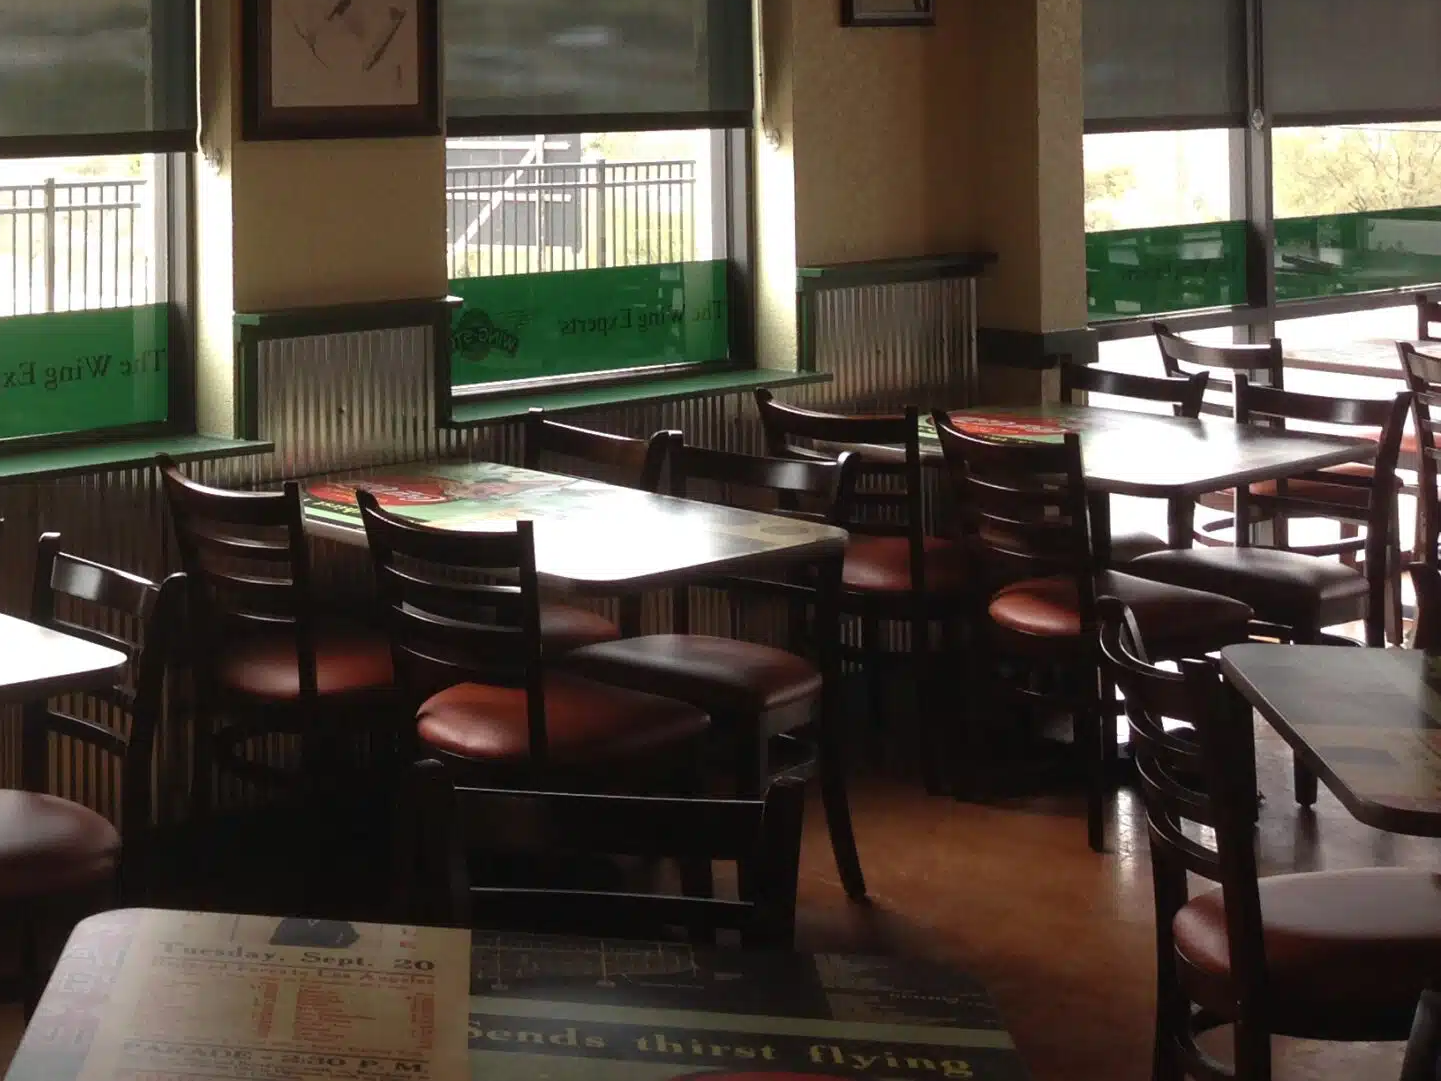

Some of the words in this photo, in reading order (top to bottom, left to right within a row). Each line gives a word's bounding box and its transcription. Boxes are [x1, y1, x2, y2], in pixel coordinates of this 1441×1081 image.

[392, 958, 435, 971] 20
[468, 1019, 608, 1050] Sends
[636, 1032, 777, 1063] thirst
[807, 1042, 975, 1080] flying
